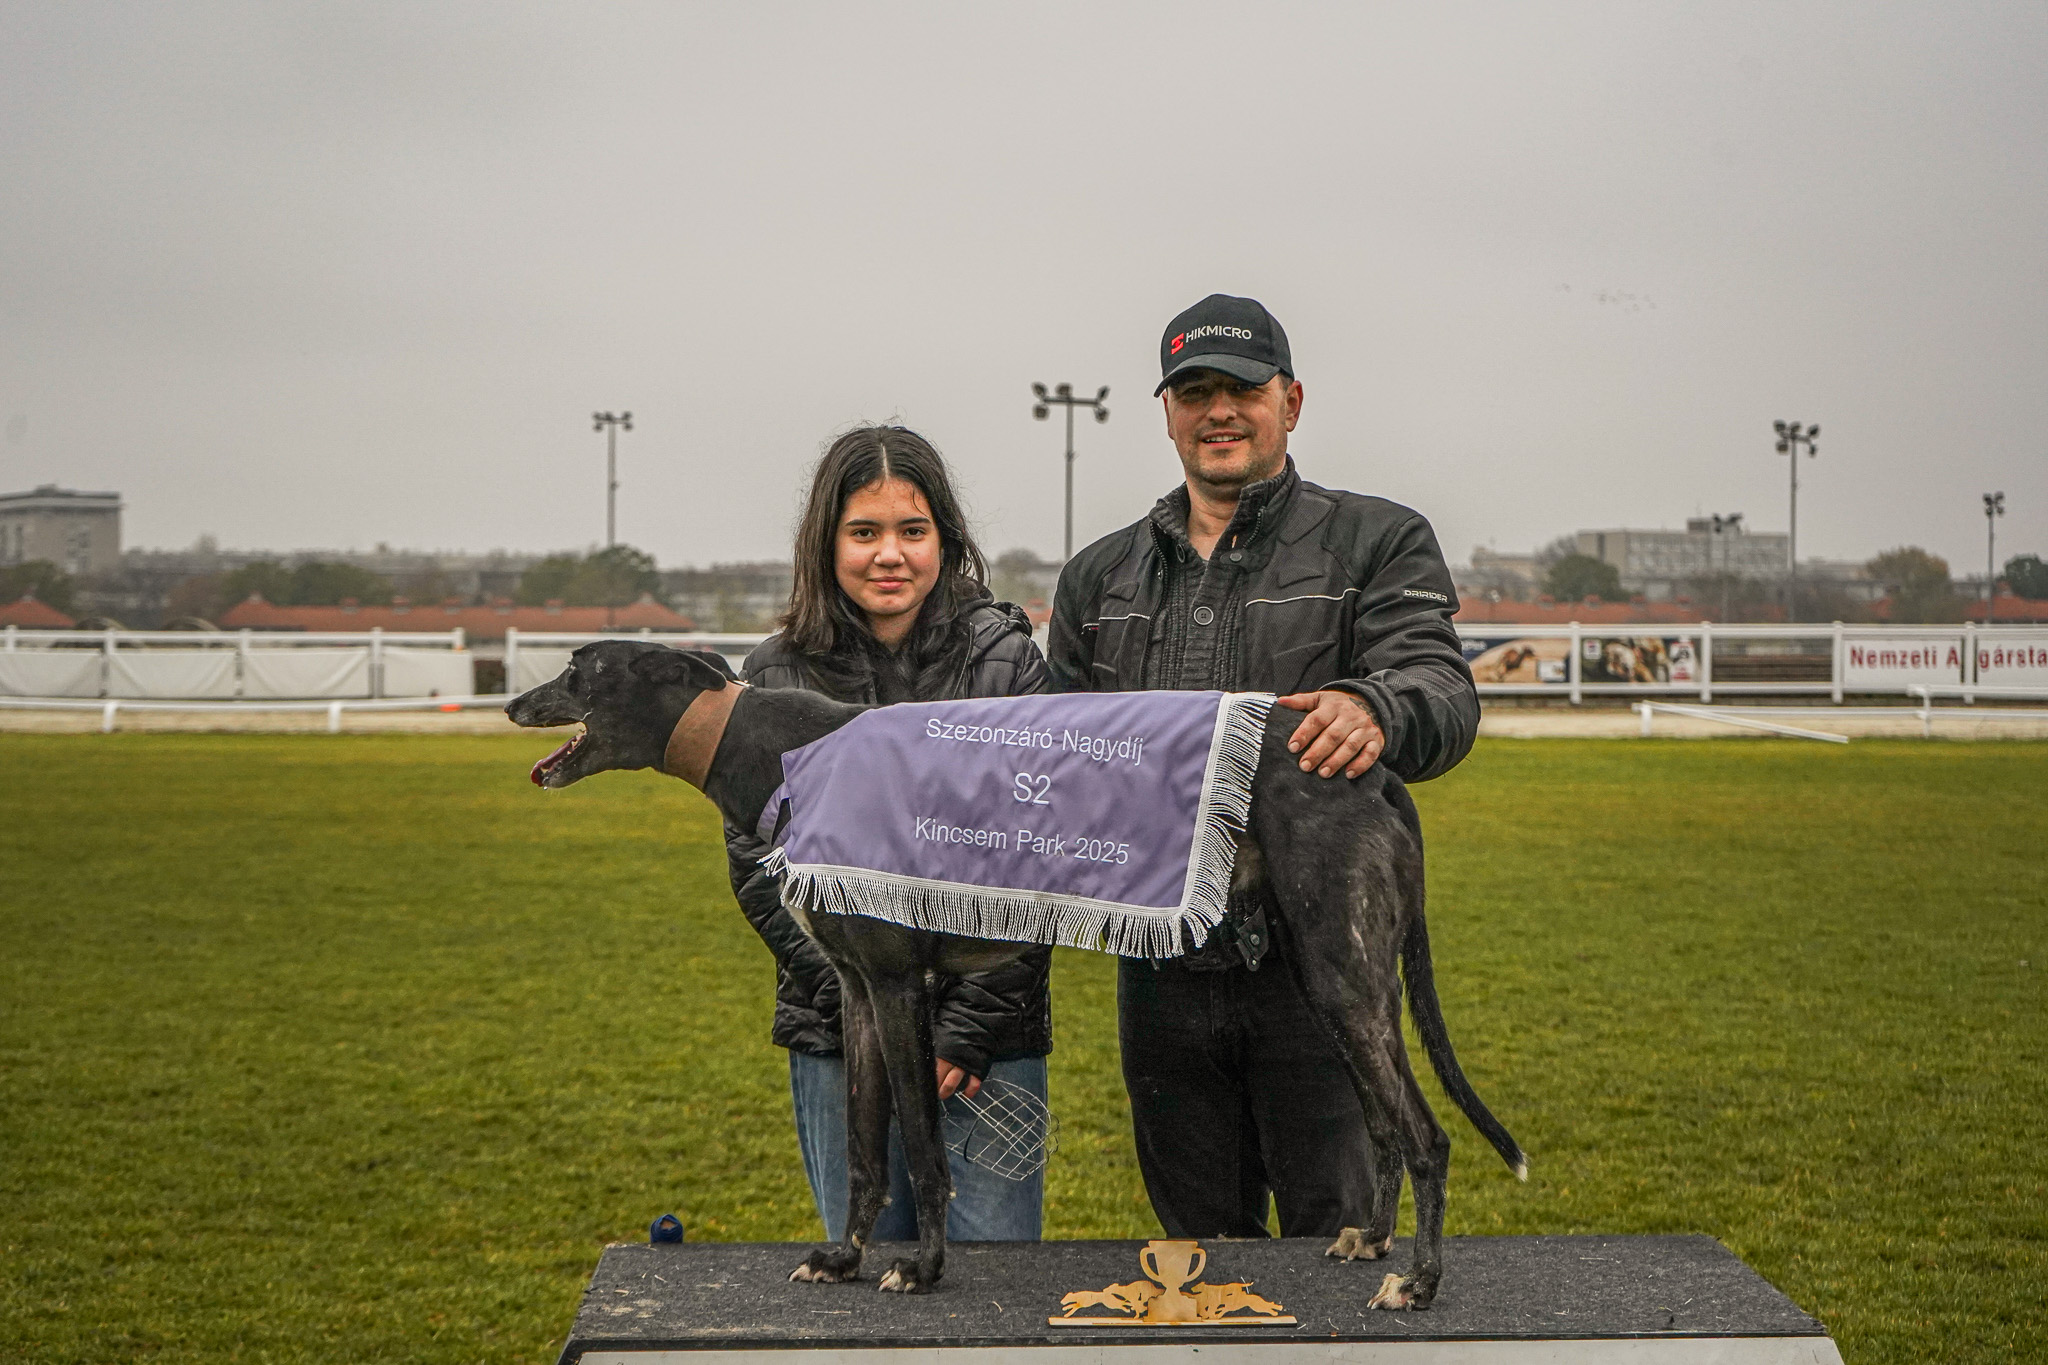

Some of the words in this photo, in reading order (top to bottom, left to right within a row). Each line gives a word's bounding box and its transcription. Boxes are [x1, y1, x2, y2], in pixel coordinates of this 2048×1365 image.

[1186, 325, 1252, 343] HIKMICRO
[1404, 589, 1448, 603] DRIRIDER
[1850, 645, 1938, 667] Nemzeti
[926, 718, 1053, 750] Szezonzáró
[1062, 729, 1144, 766] Nagydíj
[1013, 772, 1052, 806] S2
[915, 816, 1007, 850] Kincsem
[1016, 829, 1066, 857] Park
[1074, 837, 1130, 865] 2025
